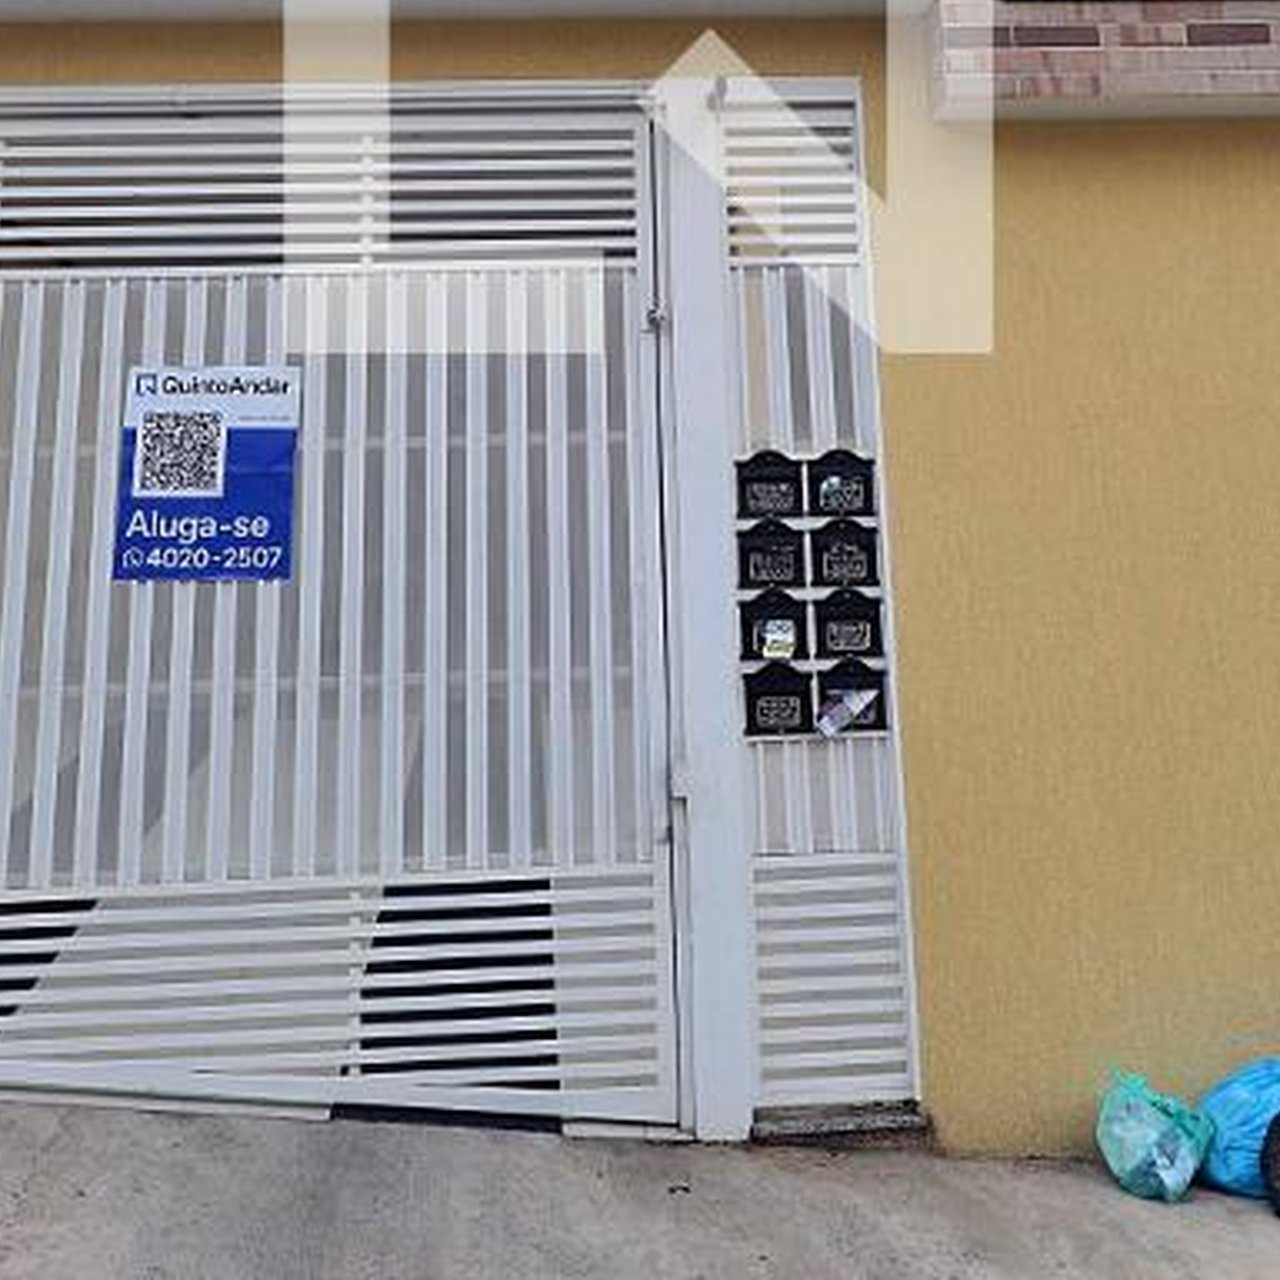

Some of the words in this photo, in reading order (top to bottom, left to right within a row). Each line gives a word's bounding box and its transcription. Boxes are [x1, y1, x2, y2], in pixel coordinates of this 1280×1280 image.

[162, 376, 291, 395] QuintoAndar
[125, 510, 270, 544] Aluga-se
[146, 546, 283, 568] 4020-2507
